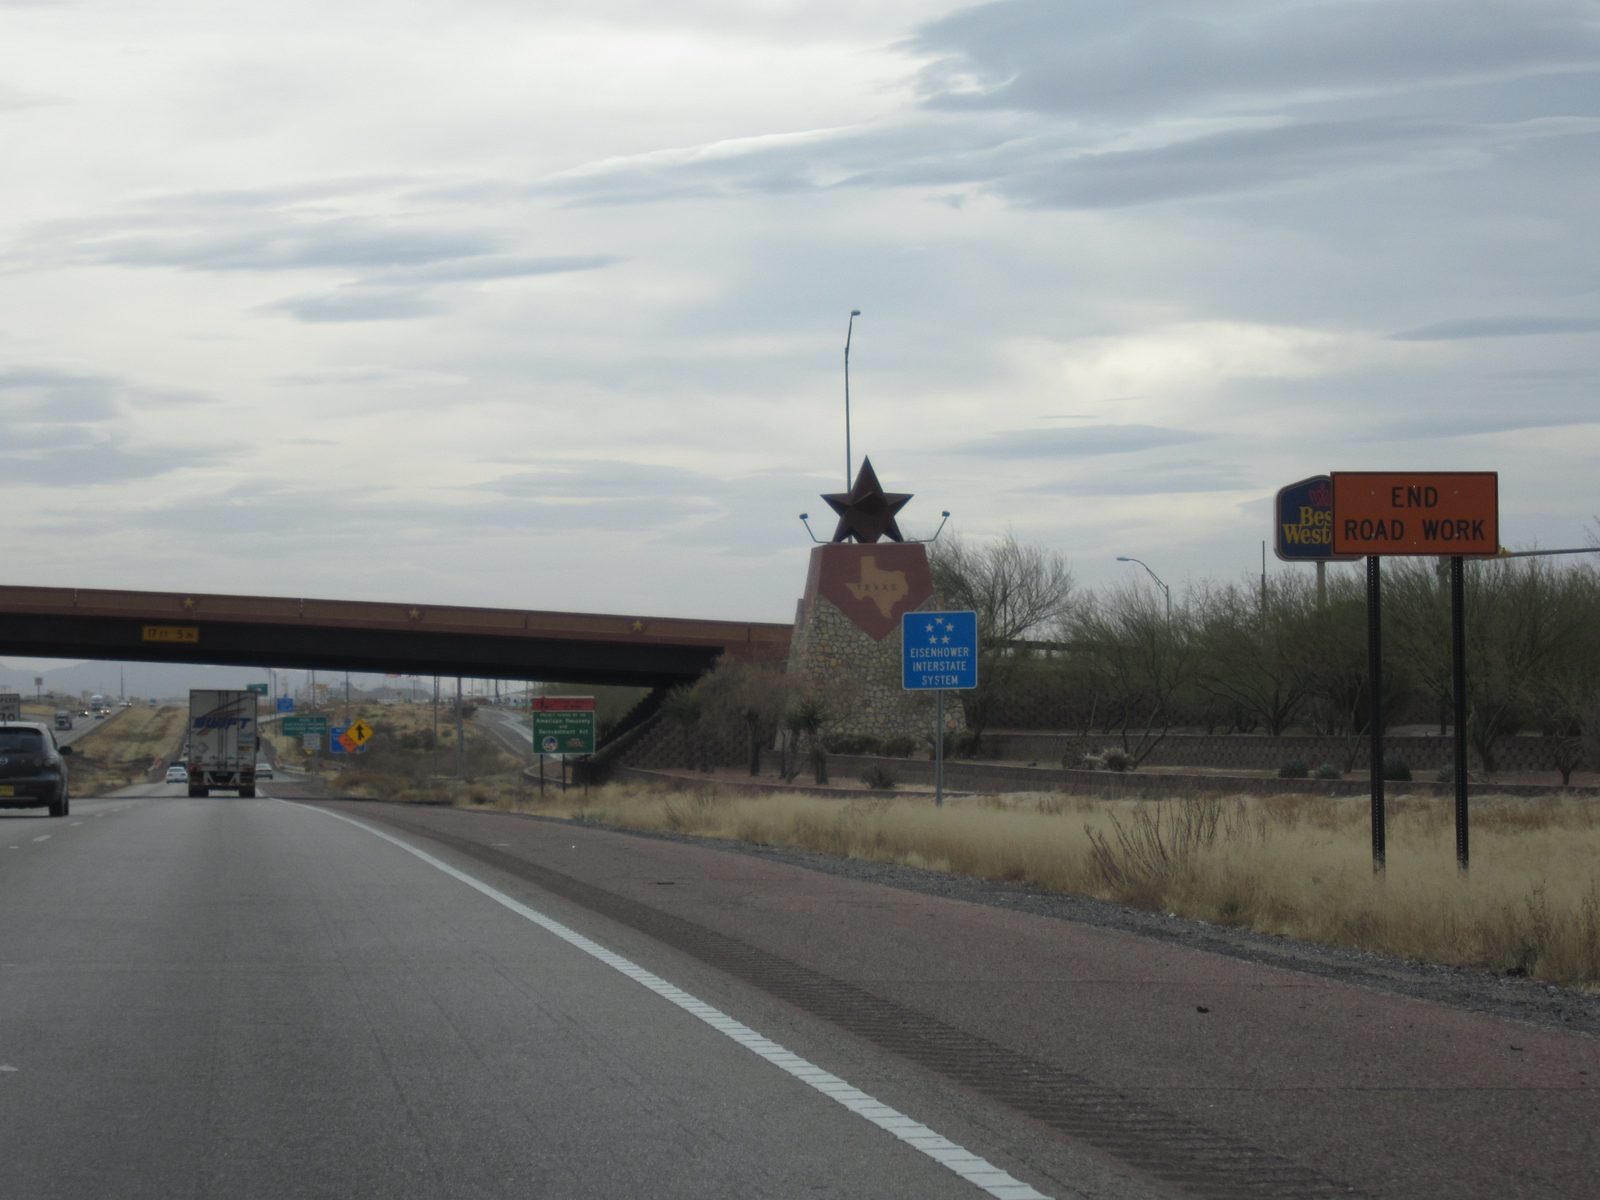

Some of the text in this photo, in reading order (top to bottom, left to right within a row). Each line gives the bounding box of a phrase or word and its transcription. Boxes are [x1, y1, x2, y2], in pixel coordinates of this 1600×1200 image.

[1391, 486, 1439, 508] END
[1298, 505, 1332, 526] Bes
[1282, 523, 1332, 545] West
[1344, 519, 1485, 541] ROAD WORK
[857, 583, 898, 592] TEXAS
[176, 628, 184, 639] 5
[910, 647, 969, 659] EISENHOWER
[912, 660, 967, 672] INTERSTATE
[921, 674, 959, 686] SYSTEM
